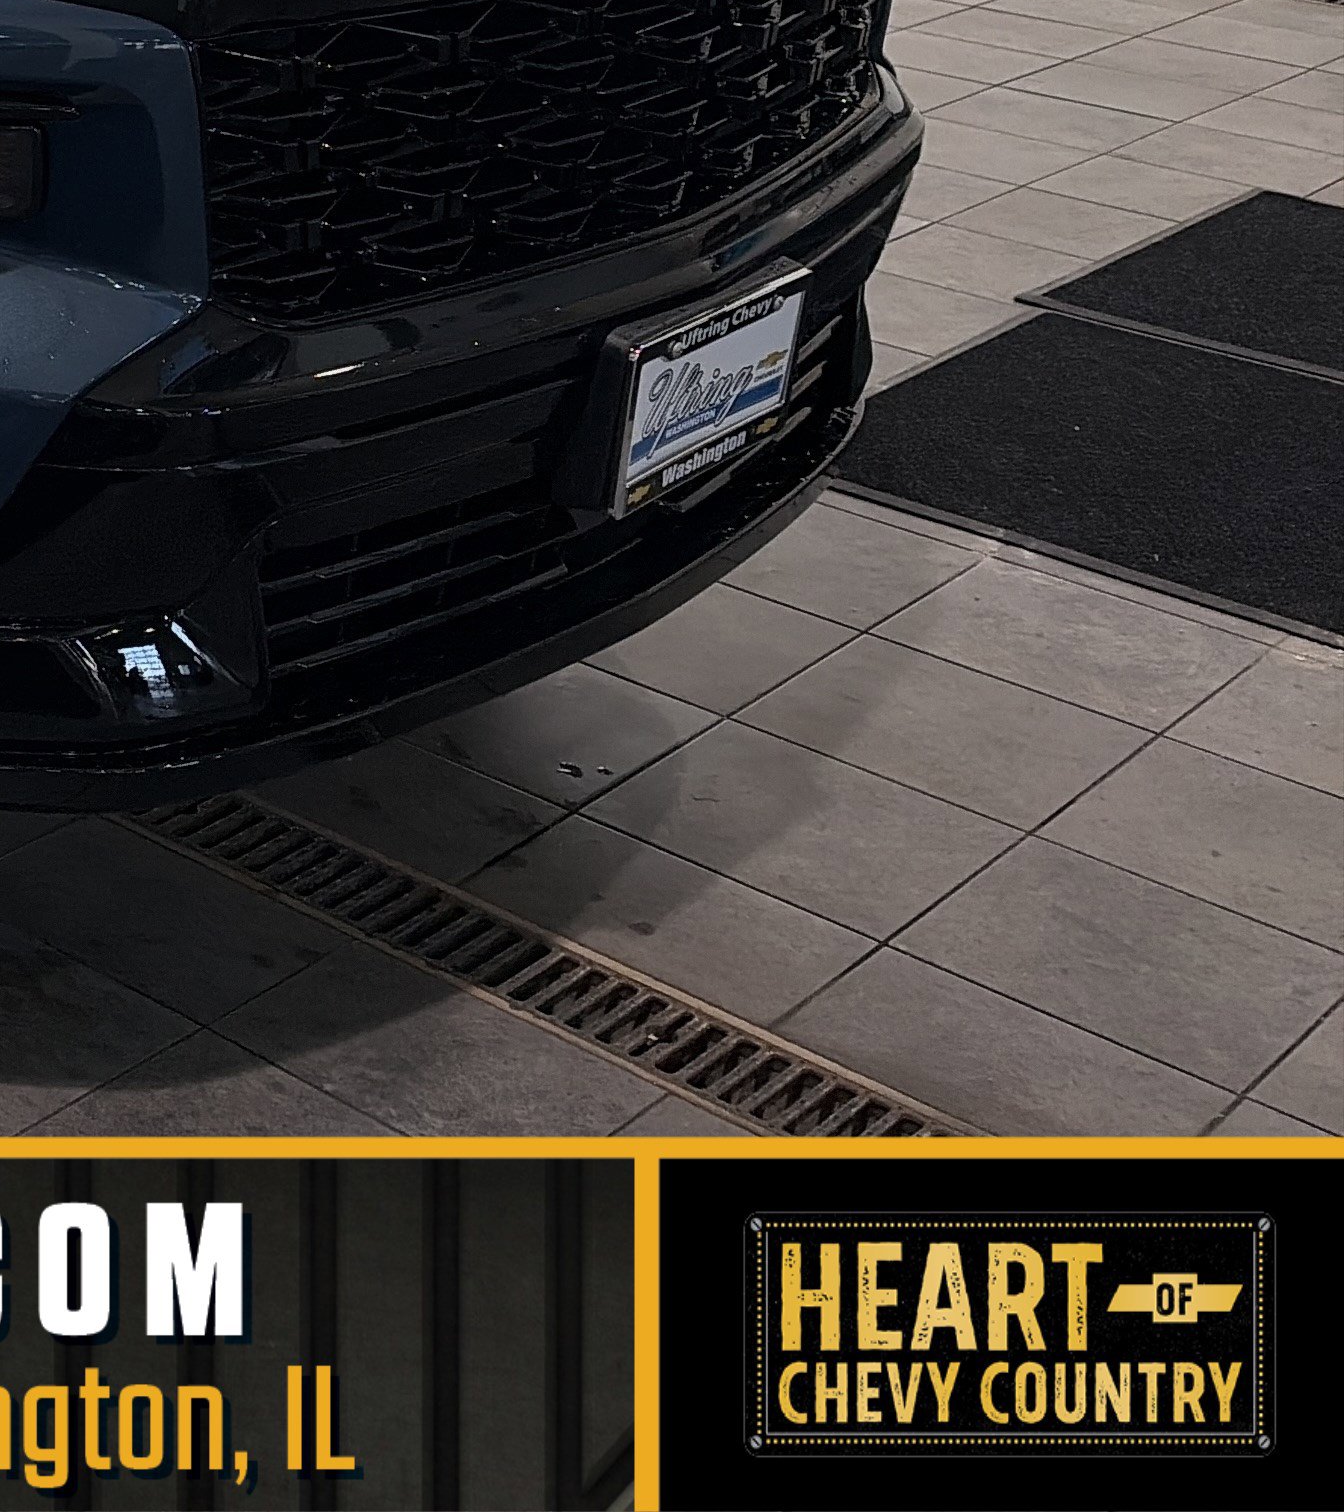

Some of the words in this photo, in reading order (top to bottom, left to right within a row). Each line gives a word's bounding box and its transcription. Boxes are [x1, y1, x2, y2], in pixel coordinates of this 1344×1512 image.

[682, 319, 729, 349] Uftring
[731, 297, 773, 326] Chevy
[661, 430, 747, 488] Washington
